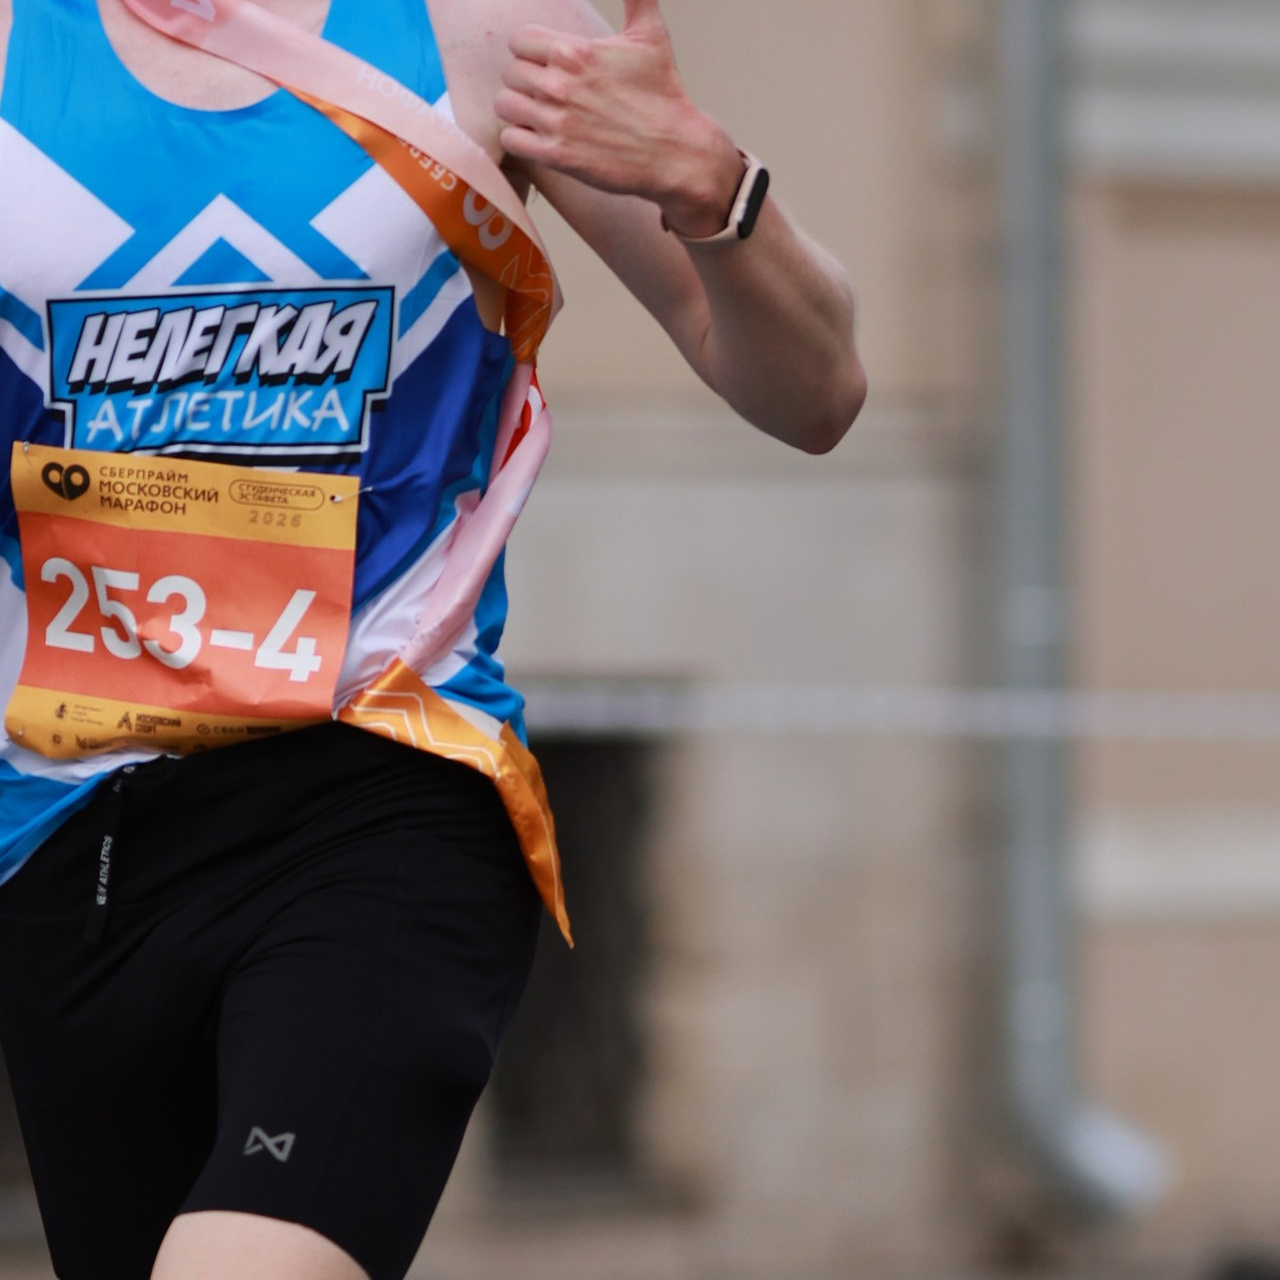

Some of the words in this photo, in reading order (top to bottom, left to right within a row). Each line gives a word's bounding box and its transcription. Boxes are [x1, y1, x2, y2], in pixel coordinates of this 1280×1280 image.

[66, 300, 379, 390] НЕЛЕГКАЯ
[87, 388, 350, 443] АТЛЕТИКА
[99, 465, 188, 483] СБЕРПРАЙМ
[99, 480, 219, 503] МОСКОВСКИЙ
[99, 495, 187, 516] МАРАФОН
[248, 509, 302, 528] 2026
[40, 556, 322, 683] 253-4
